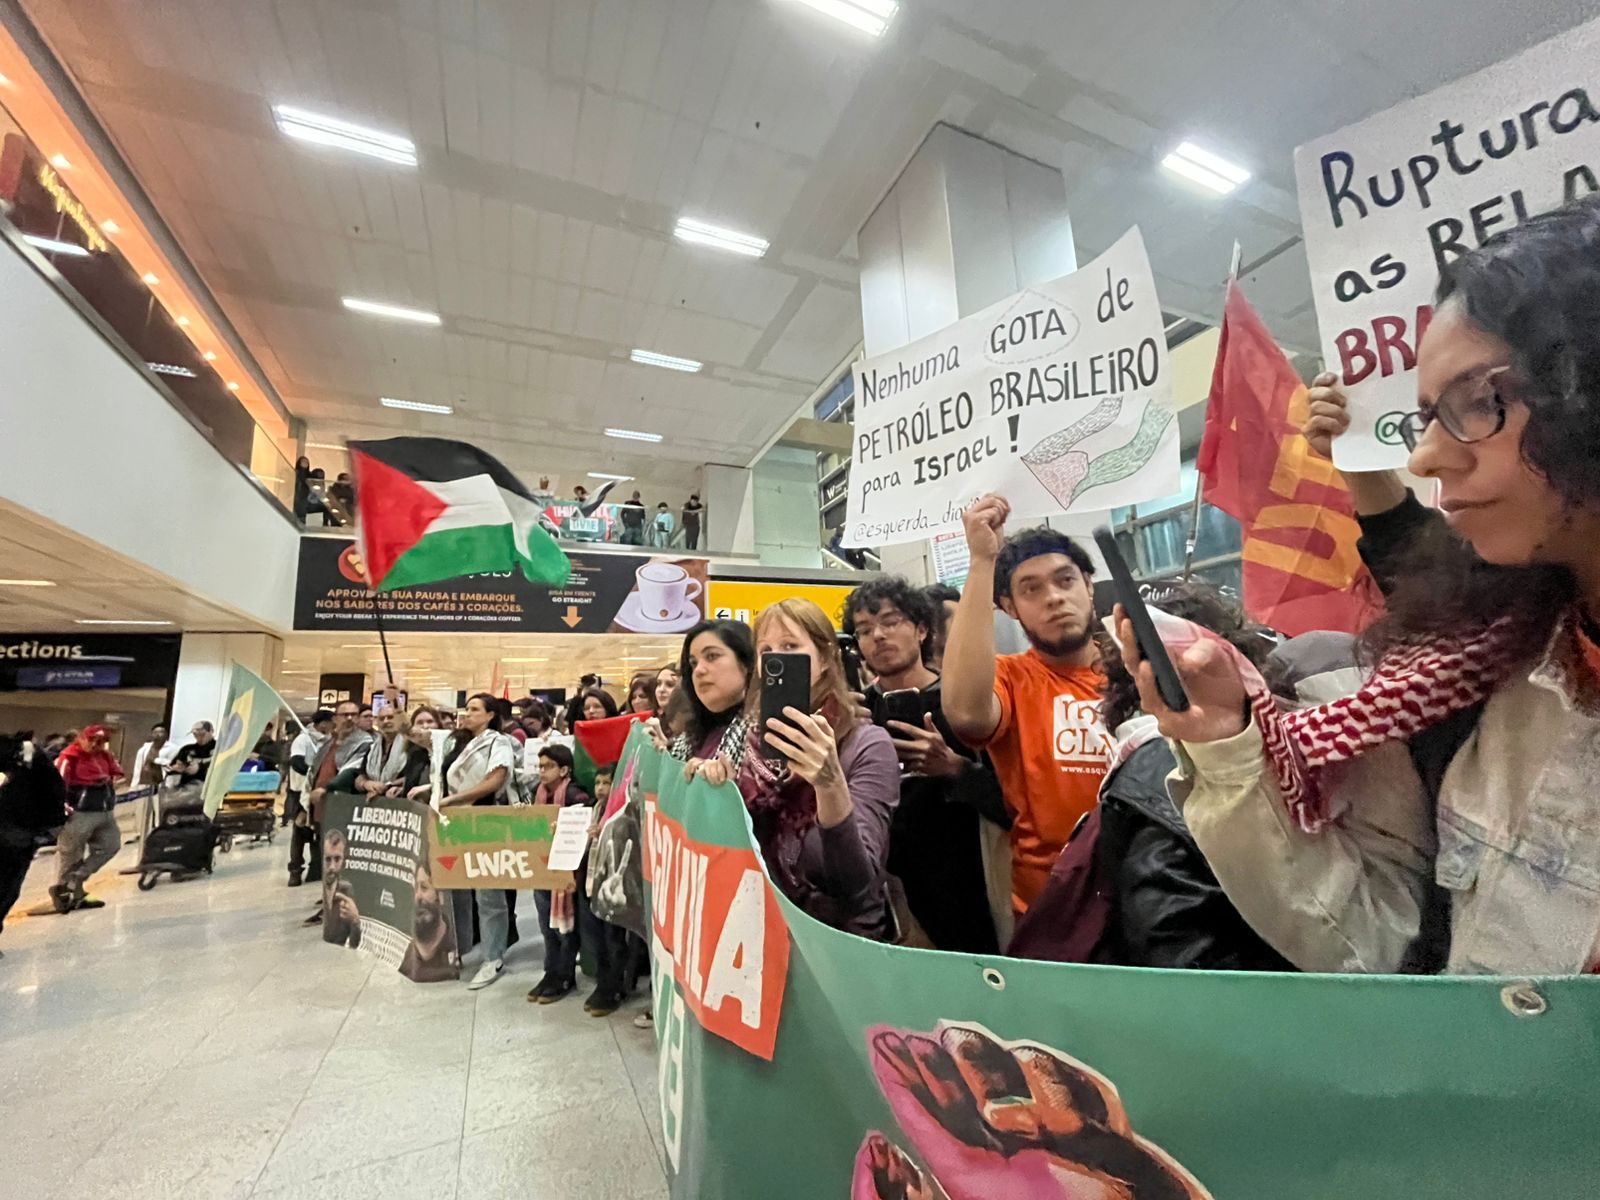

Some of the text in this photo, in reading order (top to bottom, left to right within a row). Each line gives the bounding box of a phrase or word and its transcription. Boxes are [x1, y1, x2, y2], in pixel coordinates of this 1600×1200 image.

[1320, 87, 1600, 228] Ruptura
[1334, 253, 1407, 302] as
[862, 268, 1134, 407] Nenhuma GOTA de
[858, 391, 973, 463] PETRÓLEO
[862, 470, 901, 514] para
[315, 600, 340, 609] NOS
[397, 602, 421, 611] DOS
[423, 601, 456, 611] CAFÉS
[458, 603, 465, 611] 3
[392, 591, 413, 599] SUA
[415, 591, 449, 600] PAUSA
[452, 592, 457, 600] E
[460, 593, 516, 602] EMBARQUE
[352, 806, 408, 829] LIBERDADE
[347, 824, 391, 846] THIAGO
[391, 829, 398, 846] E
[345, 860, 369, 871] TODOS
[349, 847, 373, 859] TODOS
[464, 849, 534, 880] LIVRE
